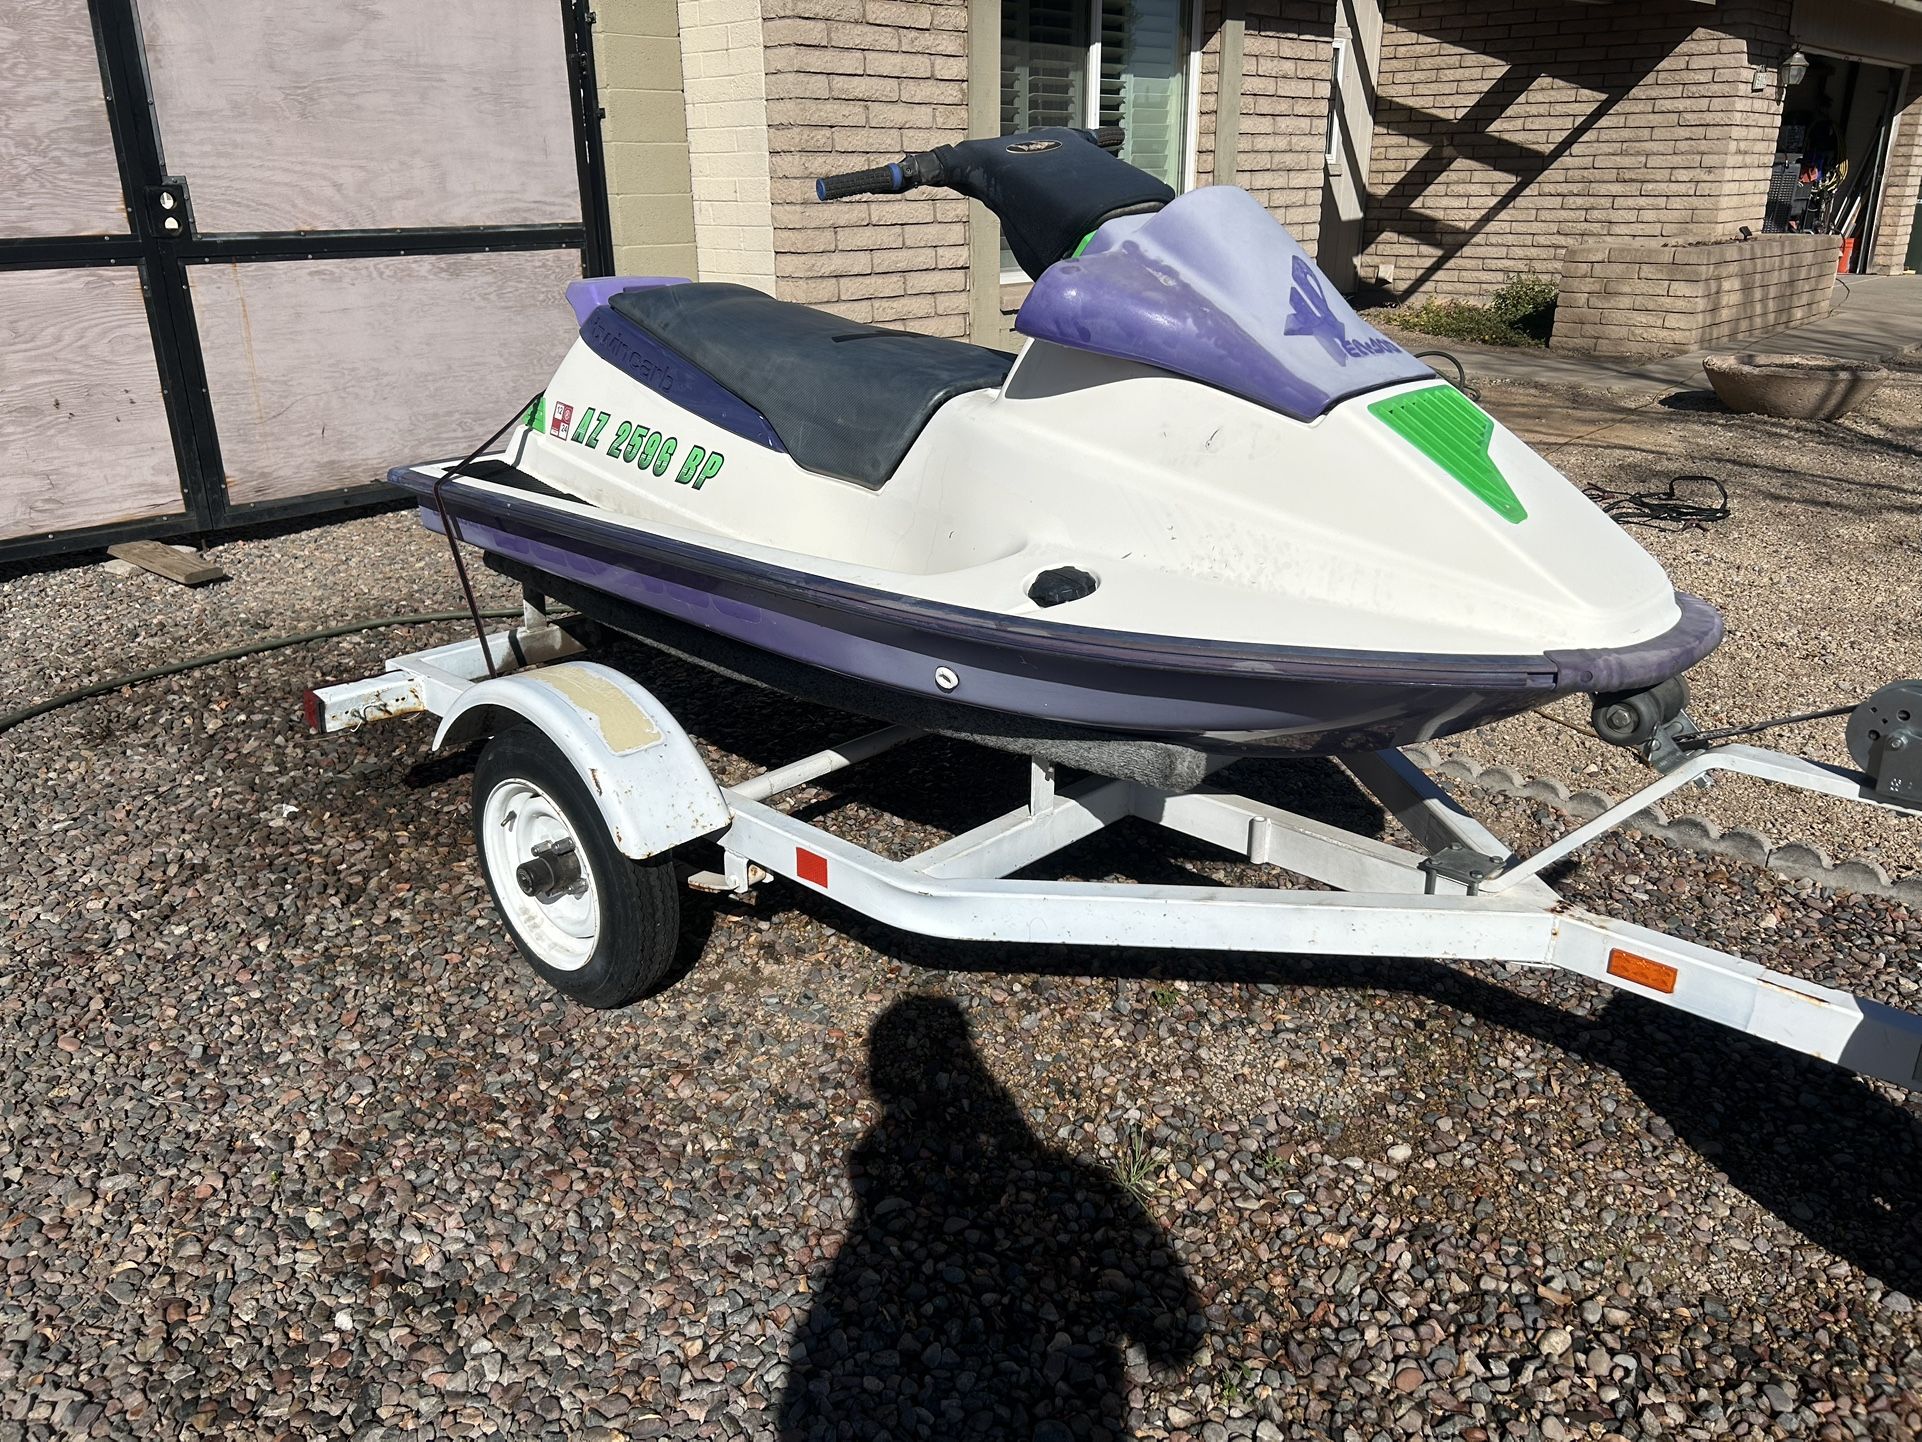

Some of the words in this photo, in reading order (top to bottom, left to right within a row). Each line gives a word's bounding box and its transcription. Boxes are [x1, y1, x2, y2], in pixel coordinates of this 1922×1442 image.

[557, 405, 565, 416] 12
[561, 423, 569, 434] 24
[571, 406, 611, 450] AZ
[606, 420, 678, 477] 2596
[674, 444, 725, 490] BP
